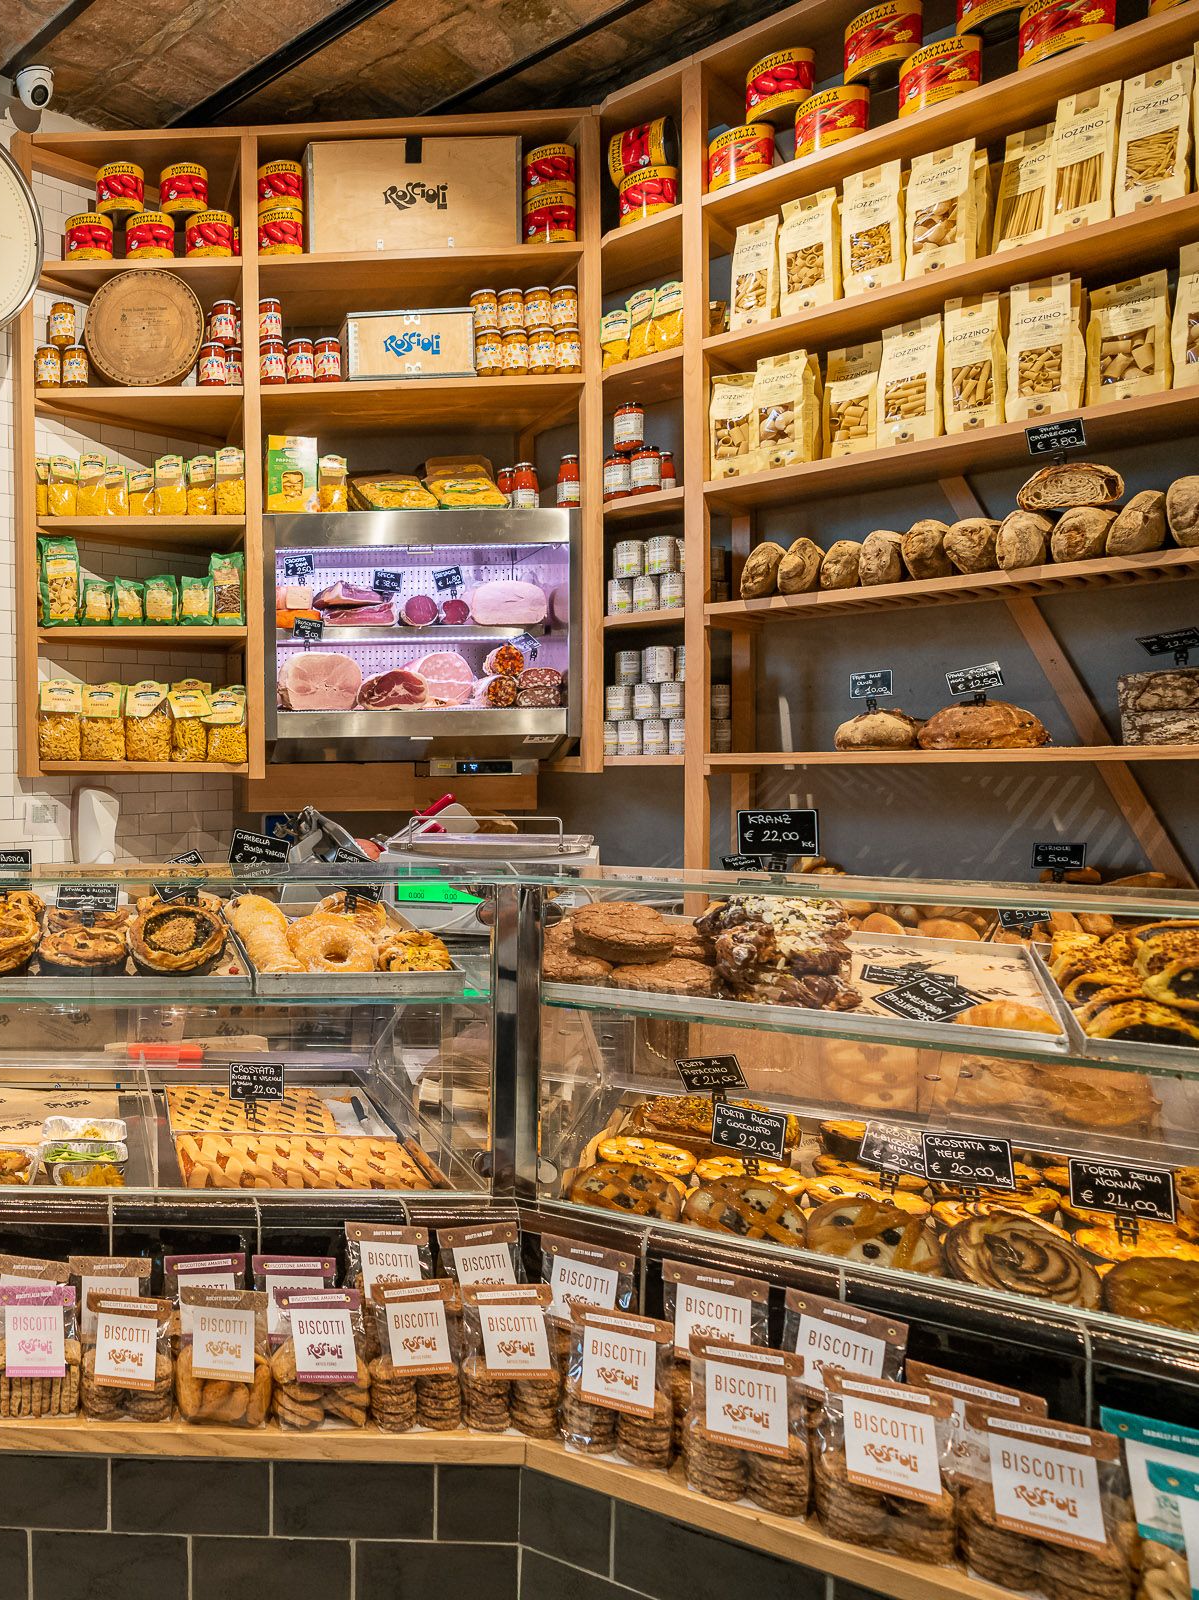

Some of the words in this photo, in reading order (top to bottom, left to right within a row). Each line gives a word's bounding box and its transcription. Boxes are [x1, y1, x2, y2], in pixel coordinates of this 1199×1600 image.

[849, 3, 899, 33] POMILIA
[912, 40, 963, 67] POMILIA
[752, 52, 796, 80] POMILIA
[797, 91, 840, 119] POMILIA
[1132, 93, 1179, 114] IOZZINO
[1061, 120, 1104, 141] IOZZINO
[527, 146, 573, 161] POMILIA
[100, 165, 142, 177] POMILIA
[163, 165, 206, 177] POMILIA
[259, 163, 300, 176] POMILIA
[920, 167, 956, 185] IOZZINO
[527, 196, 573, 210] POMILIA
[68, 215, 110, 228] POMILIA
[129, 215, 171, 227] POMILIA
[188, 213, 231, 226] POMILIA
[261, 210, 301, 224] POMILIA
[1104, 295, 1151, 311] IOZZINO
[1020, 311, 1061, 325] IOZZINO
[952, 327, 990, 343] IOZZINO
[893, 344, 926, 358] IOZZINO
[762, 373, 793, 385] IOZZINO
[747, 813, 792, 824] KRANZ
[743, 830, 754, 842] €
[232, 1065, 275, 1075] CROSTATA
[678, 1060, 705, 1069] TORTA
[236, 1086, 243, 1094] €
[717, 1105, 745, 1120] TORTA
[719, 1130, 729, 1141] €
[925, 1136, 985, 1153] CROSTATA
[935, 1149, 966, 1161] MELE
[930, 1162, 941, 1175] €
[1076, 1162, 1123, 1178] TORTA
[1129, 1171, 1162, 1185] DELLA
[1094, 1177, 1141, 1191] NONNA
[1080, 1189, 1095, 1204] €
[367, 1251, 415, 1269] BISCOTTI
[462, 1253, 506, 1272] BISCOTTI
[558, 1267, 611, 1294] BISCOTTI
[684, 1296, 743, 1325] BISCOTTI
[12, 1315, 57, 1332] BISCOTTI
[200, 1316, 248, 1336] BISCOTTI
[298, 1319, 346, 1336] BISCOTTI
[393, 1312, 440, 1330] BISCOTTI
[103, 1323, 151, 1345] BISCOTTI
[807, 1329, 875, 1367] BISCOTTI
